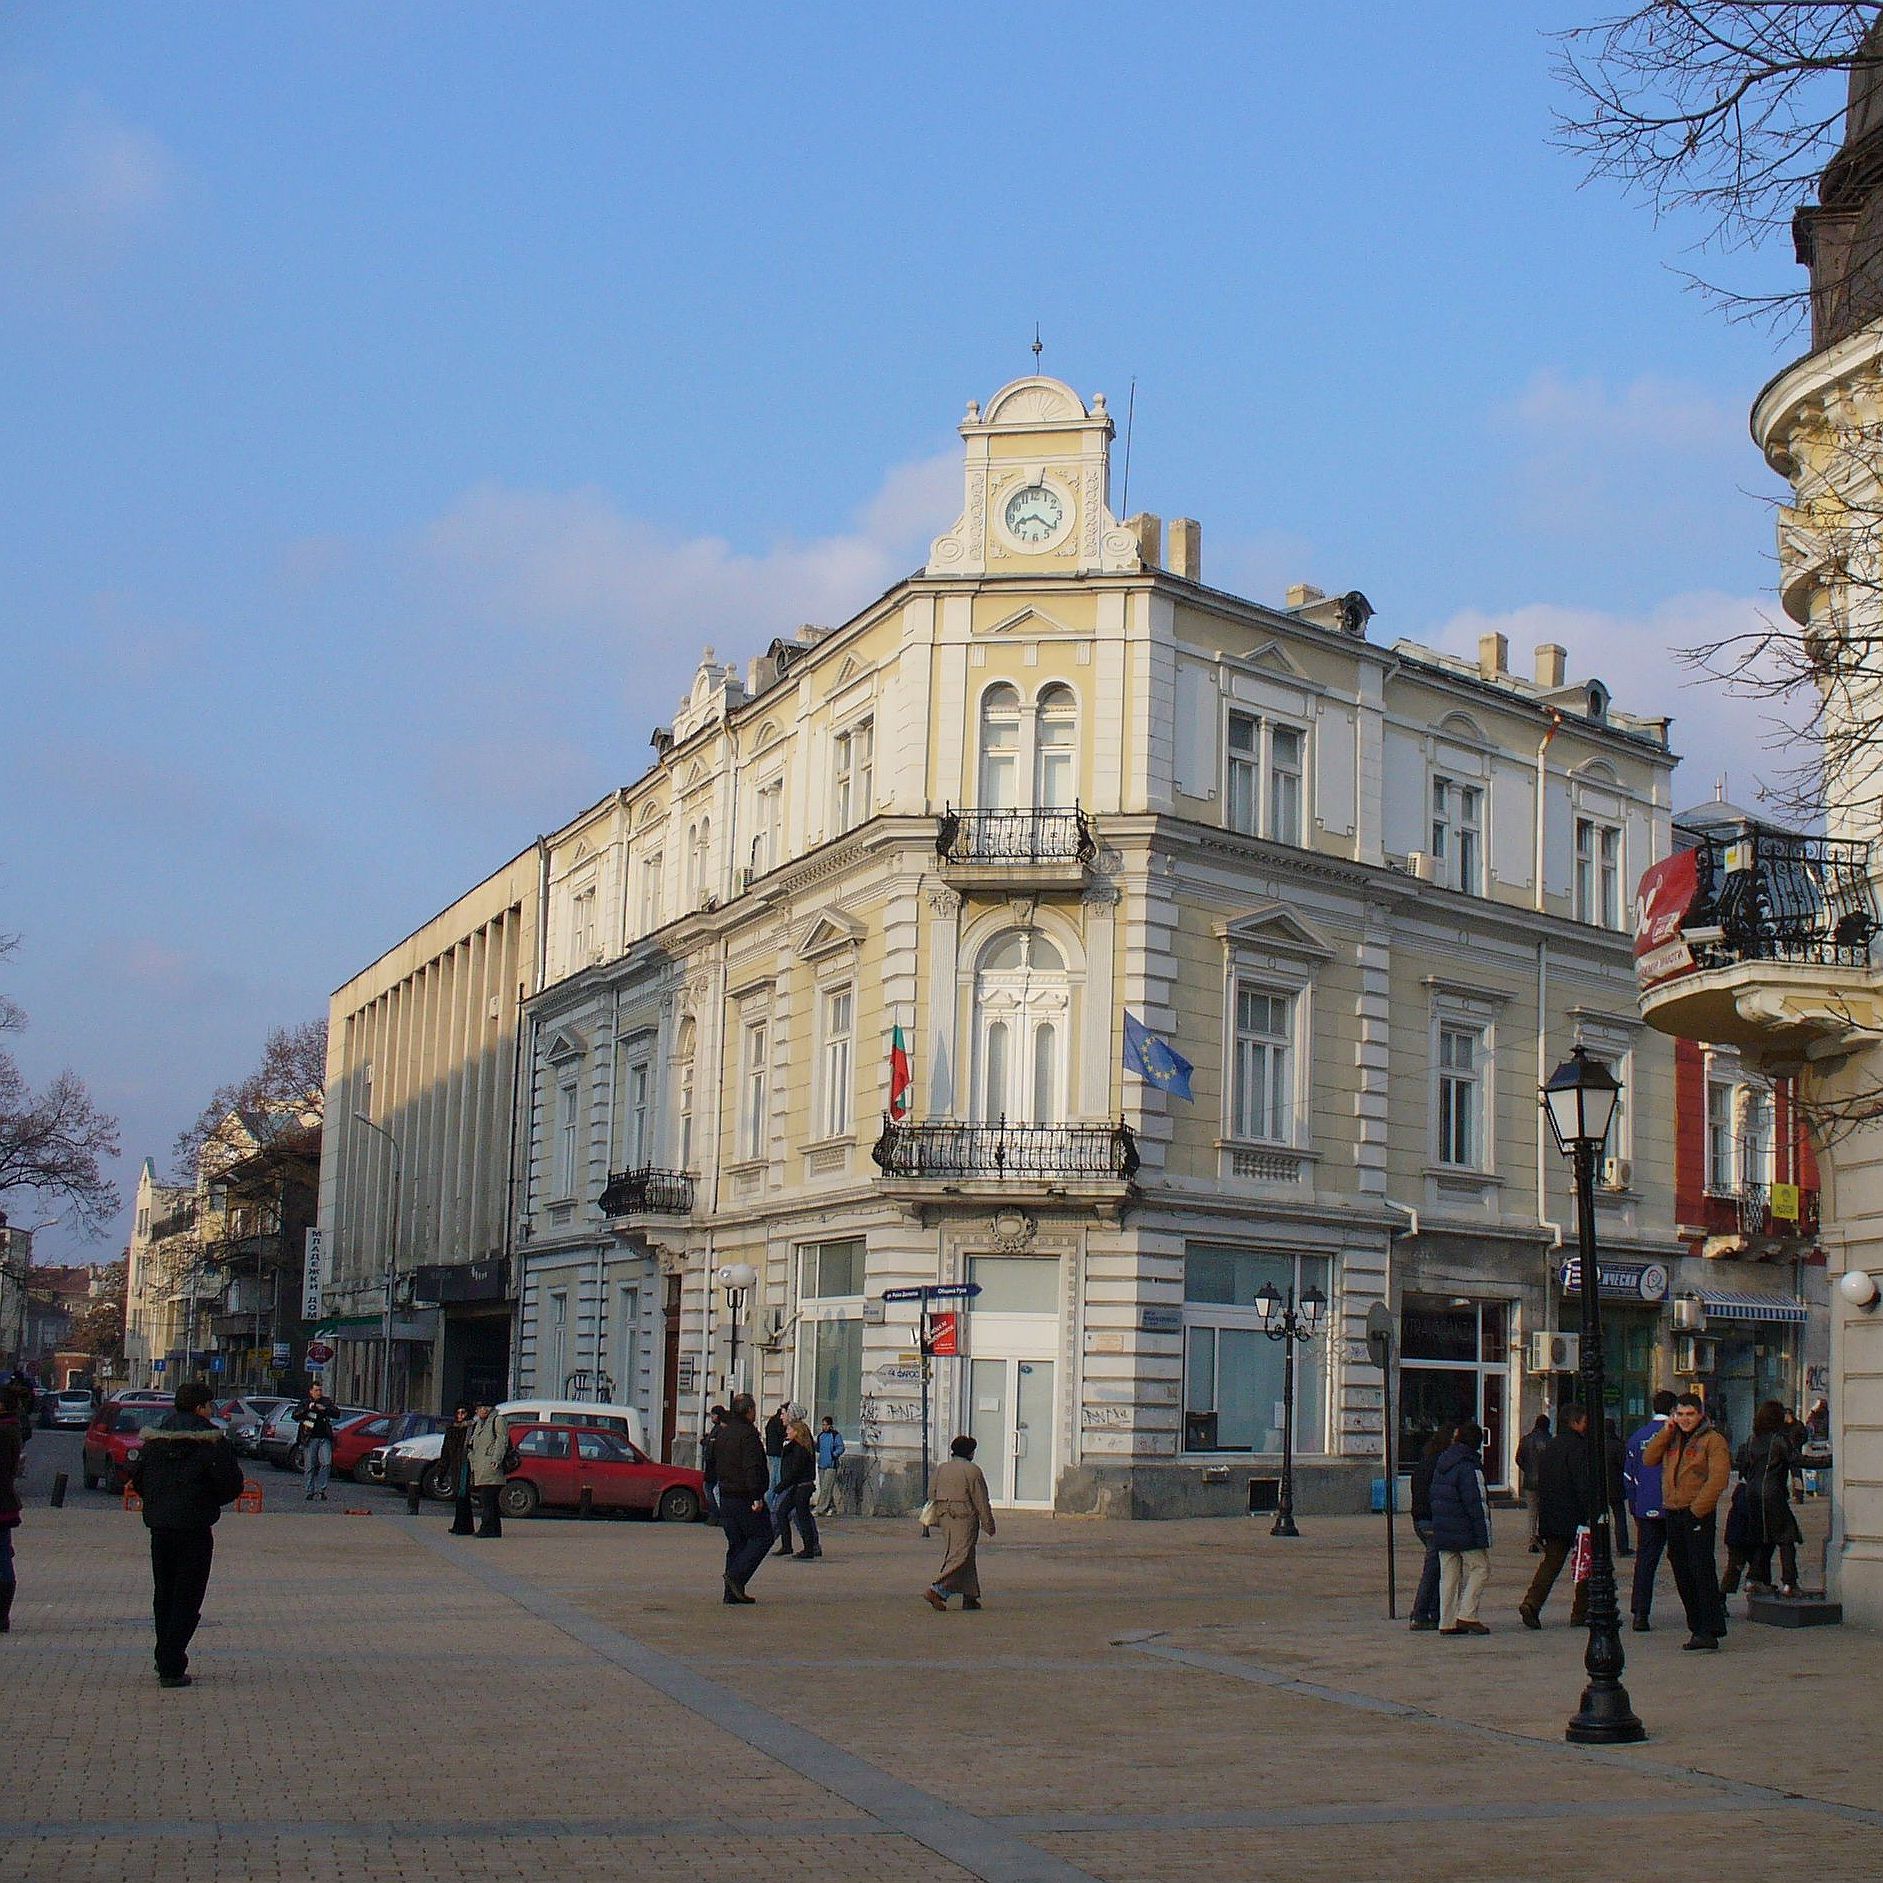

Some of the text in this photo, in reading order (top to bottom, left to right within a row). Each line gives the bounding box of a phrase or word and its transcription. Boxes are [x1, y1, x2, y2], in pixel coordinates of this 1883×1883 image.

[1022, 494, 1028, 504] 11
[1030, 492, 1040, 500] 12
[1012, 502, 1021, 512] 10
[1050, 500, 1056, 510] 2
[1010, 514, 1015, 523] 9
[1056, 510, 1062, 520] 3
[1014, 523, 1020, 534] 8
[1022, 531, 1028, 540] 7
[1044, 529, 1050, 539] 5
[308, 1297, 317, 1318] ДОМ
